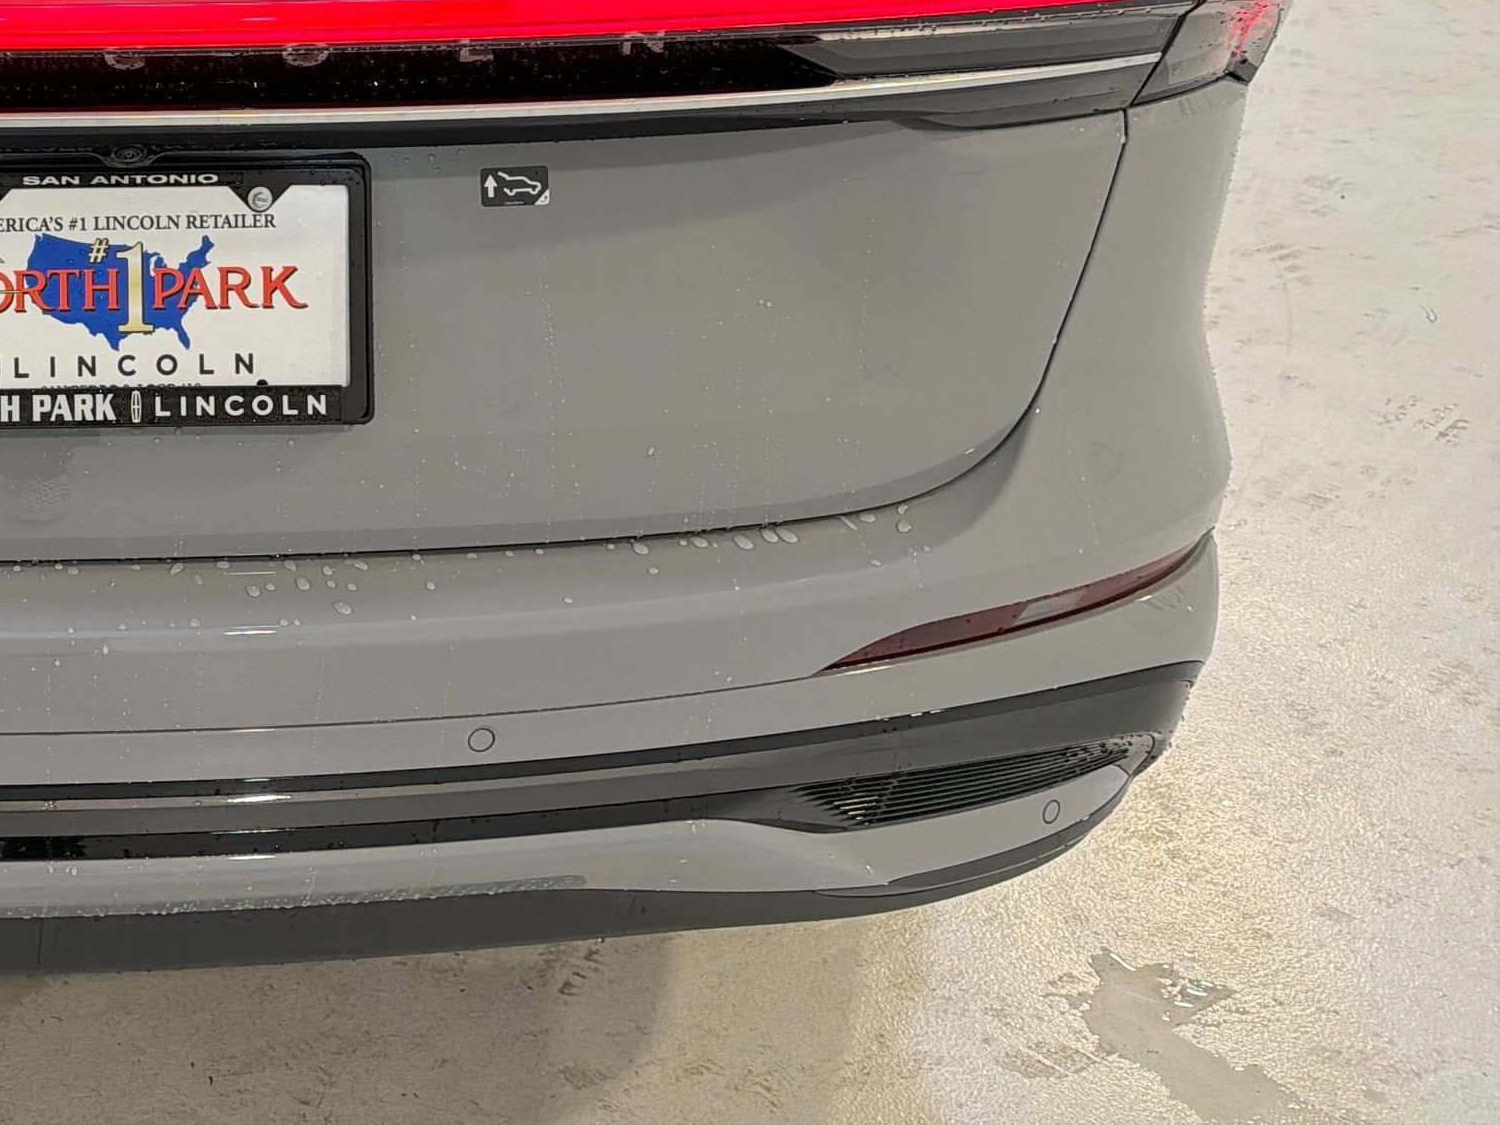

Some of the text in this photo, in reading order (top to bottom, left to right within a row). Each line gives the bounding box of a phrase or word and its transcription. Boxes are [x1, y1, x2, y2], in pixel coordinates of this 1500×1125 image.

[22, 173, 219, 186] SAN ANTONIO
[68, 216, 88, 232] #1
[93, 215, 180, 231] LINCOLN
[185, 213, 276, 230] RETAILER
[152, 265, 308, 310] PARK
[14, 353, 253, 379] LINCOLN
[32, 392, 117, 423] PARK
[155, 393, 327, 417] LINCOLN
